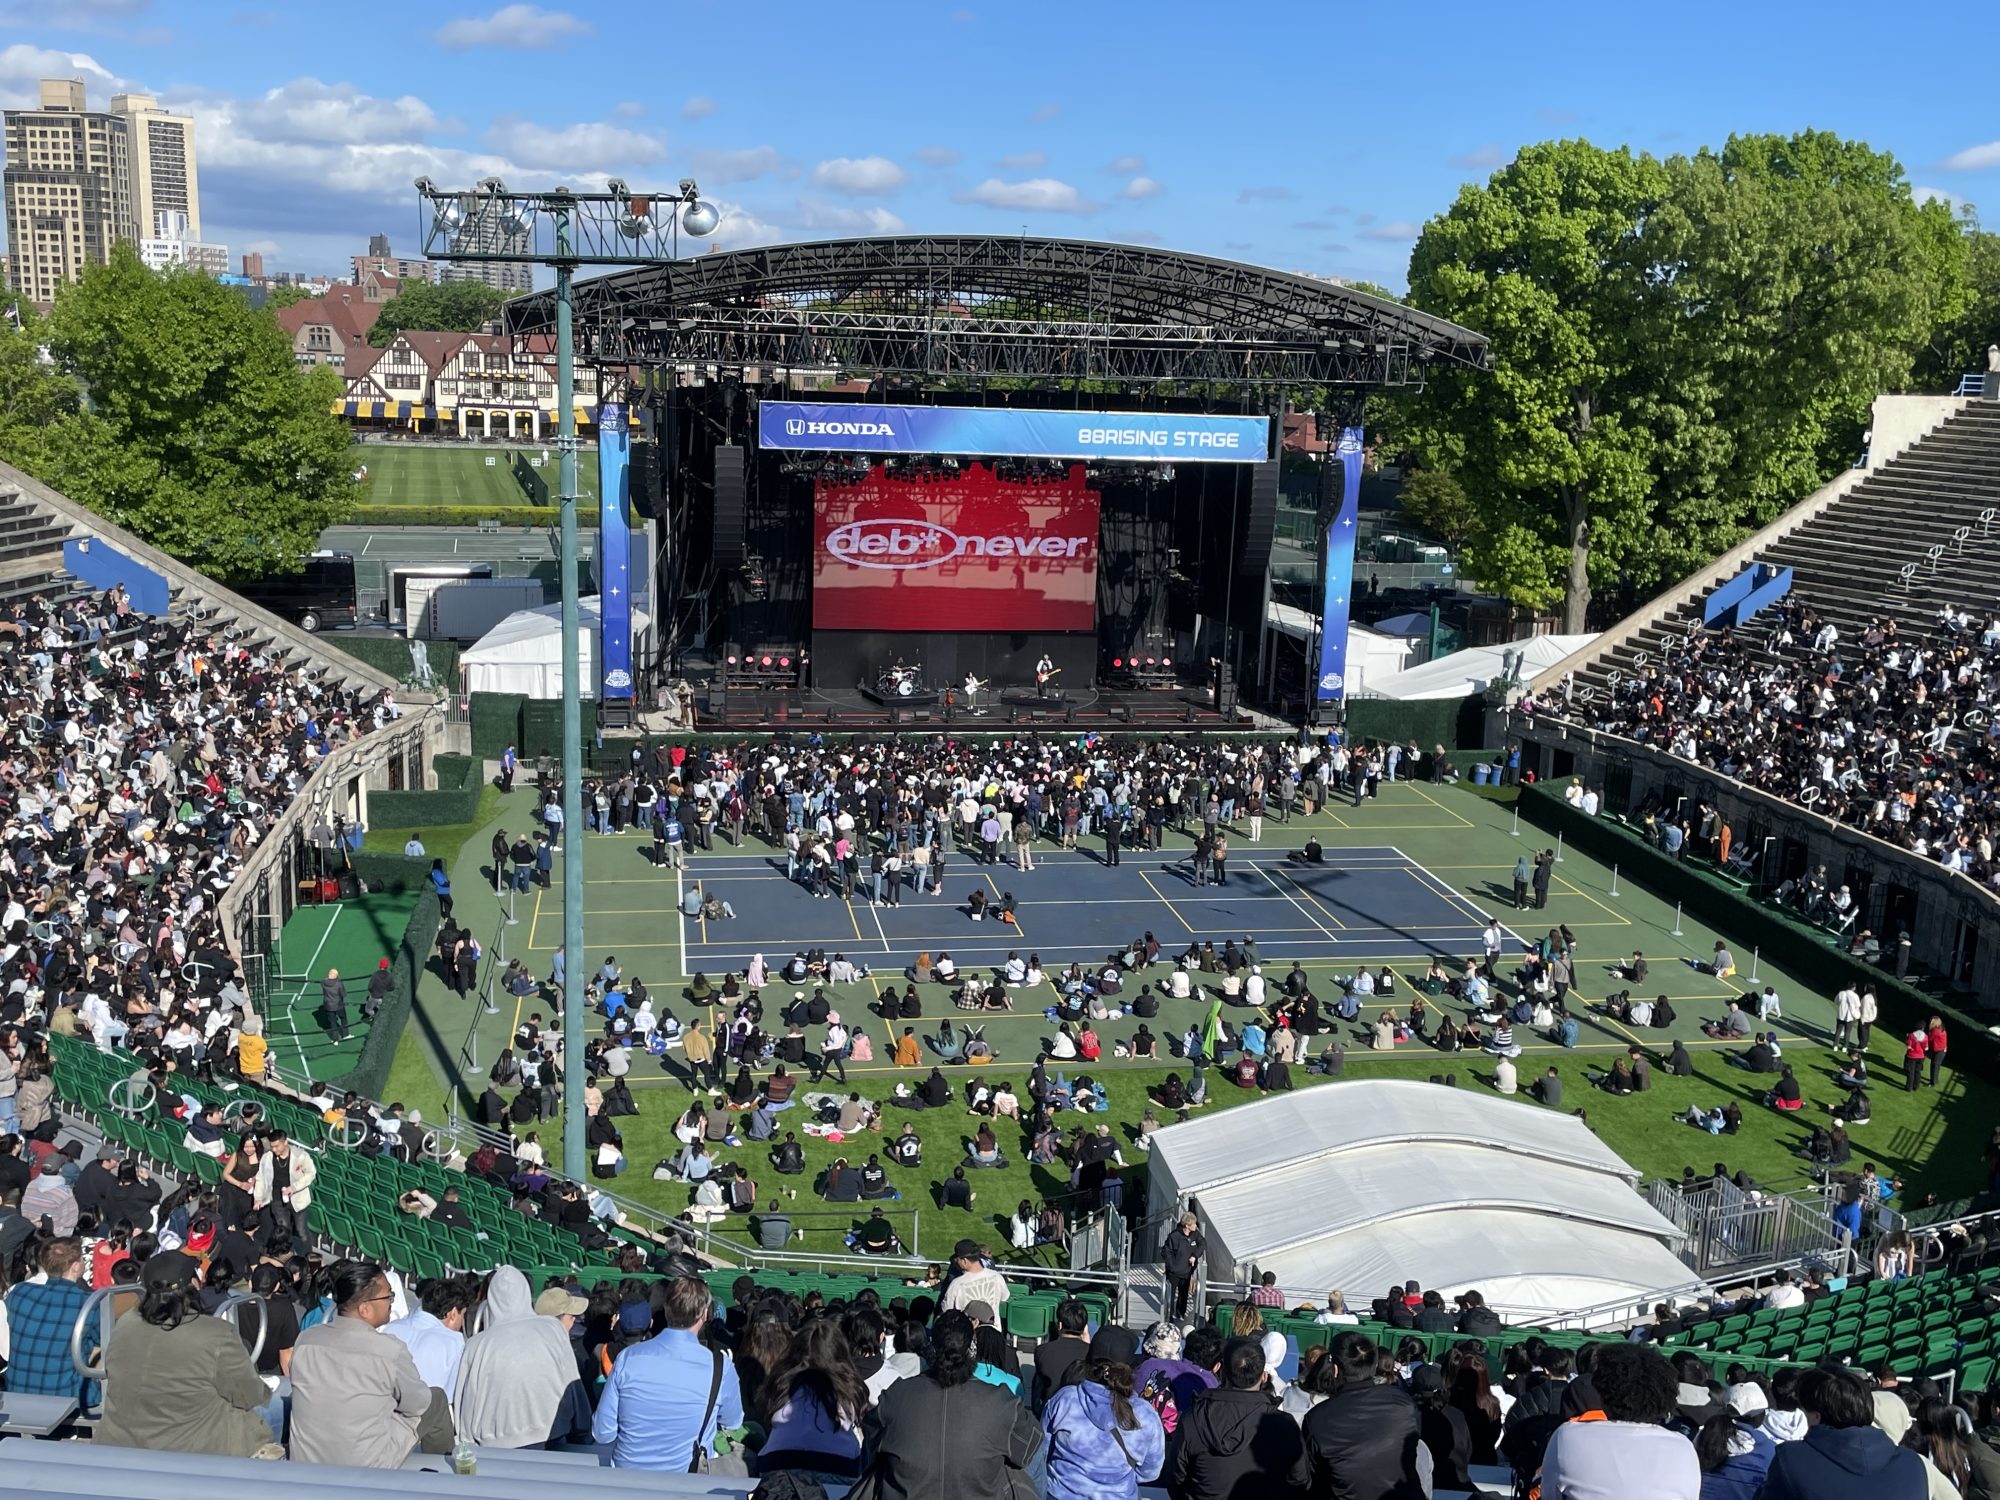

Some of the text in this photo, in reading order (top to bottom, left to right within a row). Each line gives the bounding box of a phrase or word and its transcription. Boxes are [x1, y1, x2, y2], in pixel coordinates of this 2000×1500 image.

[807, 422, 895, 436] HONDA
[1078, 428, 1239, 448] 88RISING STAGE
[956, 535, 1088, 557] never
